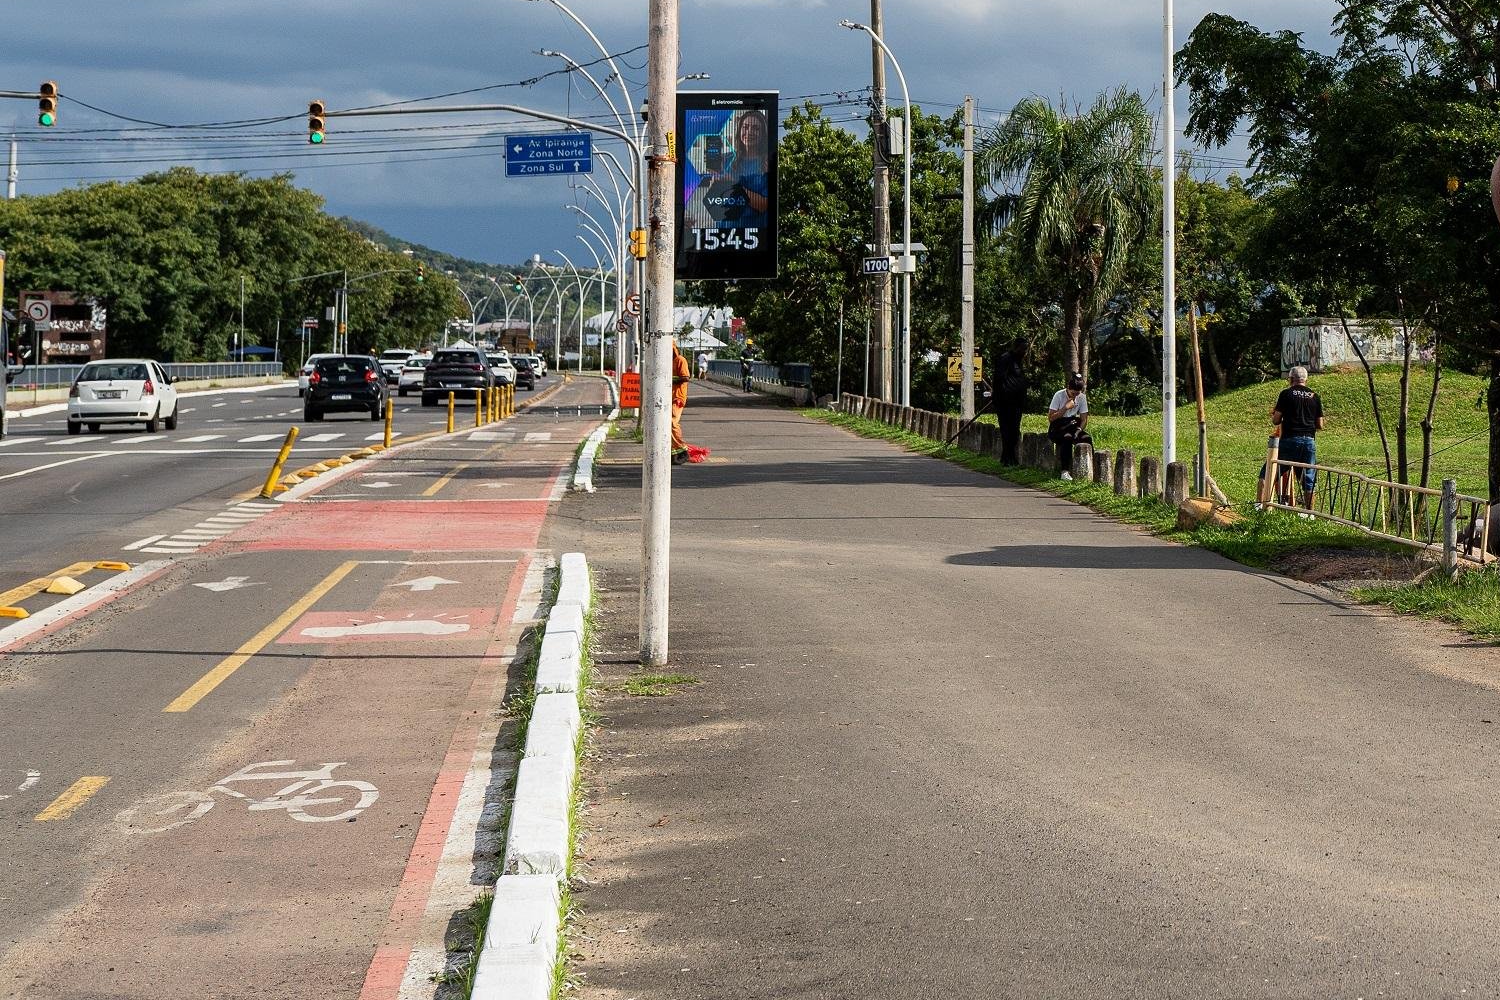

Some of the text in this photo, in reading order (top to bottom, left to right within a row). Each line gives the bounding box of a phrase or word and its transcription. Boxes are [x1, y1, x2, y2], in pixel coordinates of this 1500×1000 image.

[545, 138, 585, 149] Ipiranga
[528, 148, 584, 159] Zona Norte
[520, 163, 564, 173] Zona Sul
[707, 196, 736, 205] vero
[691, 227, 760, 251] 15:45
[865, 259, 889, 271] 1700
